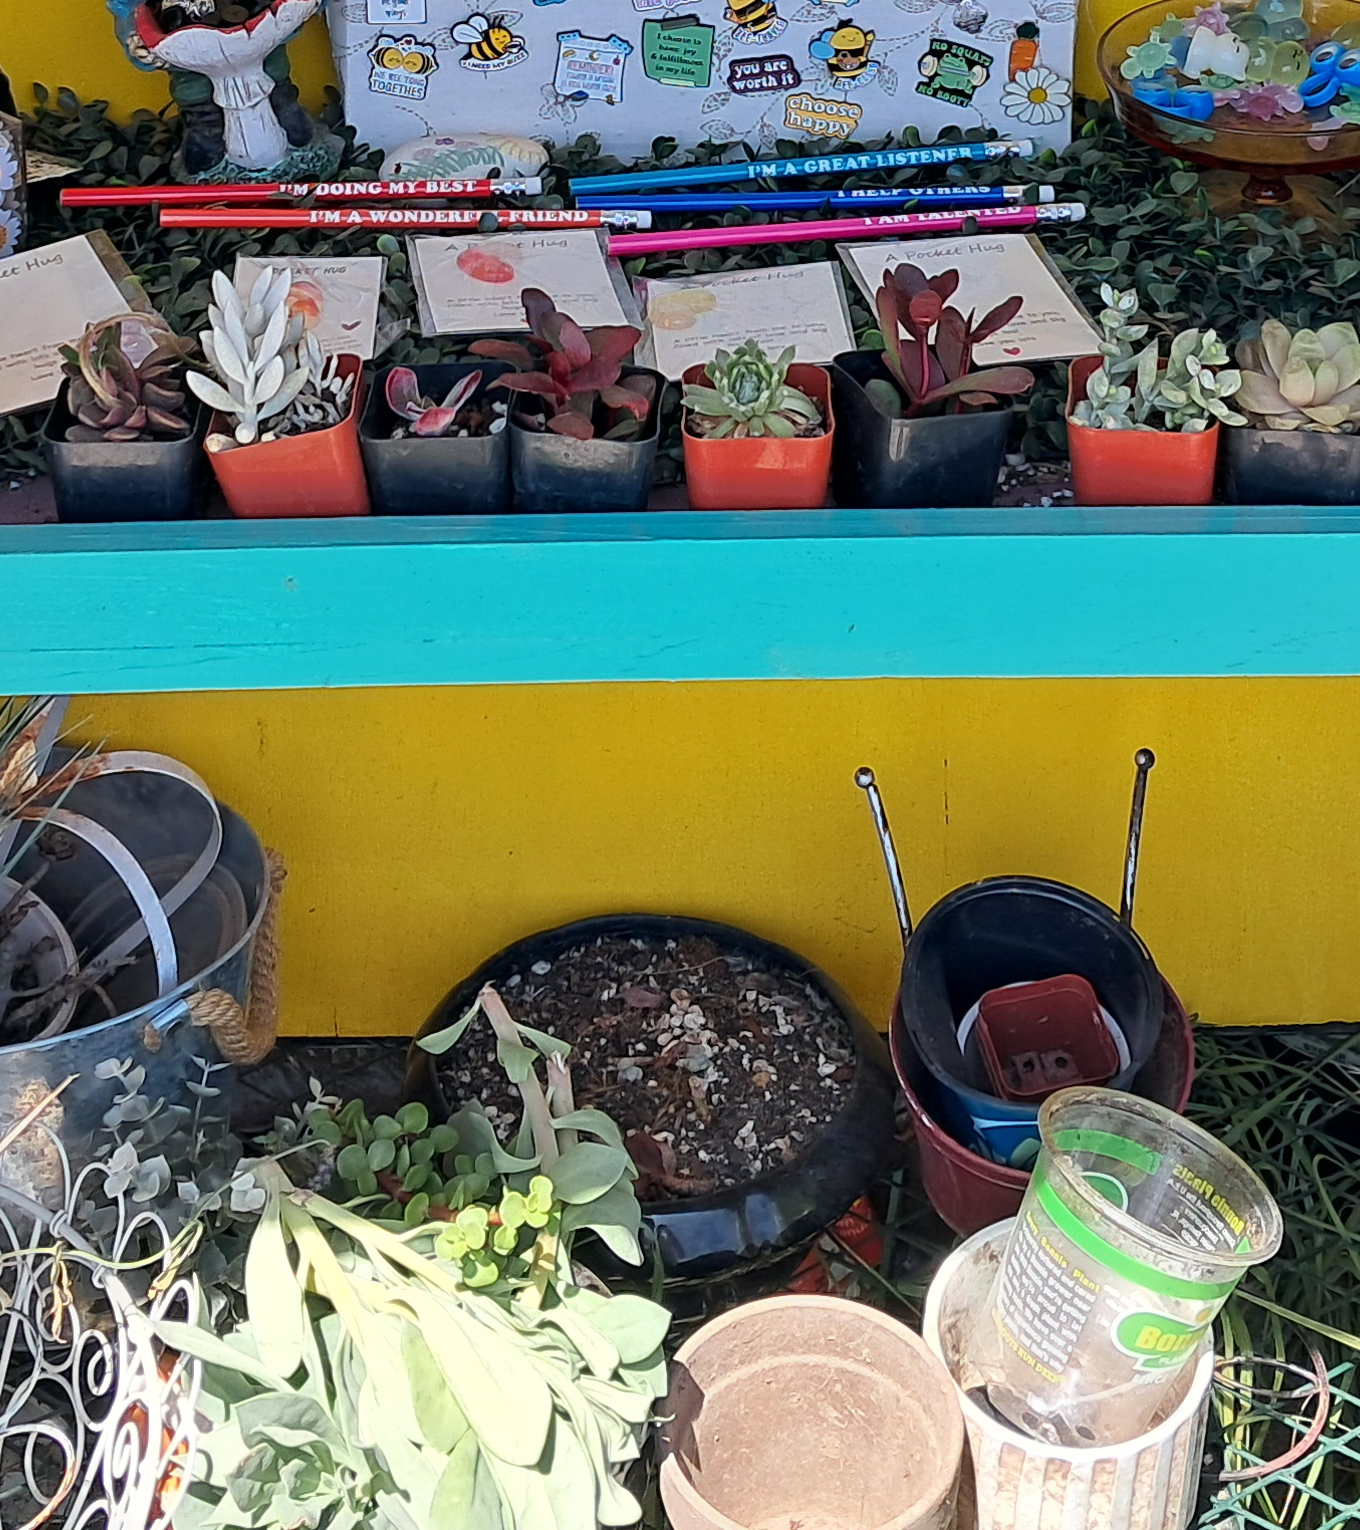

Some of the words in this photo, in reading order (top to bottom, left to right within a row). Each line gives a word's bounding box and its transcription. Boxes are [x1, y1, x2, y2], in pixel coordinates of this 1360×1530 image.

[931, 40, 948, 52] NO
[951, 45, 992, 66] SQUATS
[734, 64, 760, 78] you
[764, 60, 788, 72] are
[732, 75, 778, 90] worth
[780, 72, 794, 86] it
[788, 97, 860, 119] choose
[788, 111, 853, 137] happy
[747, 164, 776, 179] I'M
[786, 164, 799, 176] A
[804, 156, 872, 173] GREAT
[876, 147, 973, 168] LISTENER
[315, 181, 383, 195] DOING
[389, 180, 420, 195] MY
[425, 179, 477, 194] BEST
[309, 209, 340, 223] I'M
[347, 210, 362, 223] A
[509, 209, 589, 223] FRIEND
[26, 253, 64, 271] Hug
[885, 252, 897, 263] A
[904, 245, 962, 261] Pocket
[968, 242, 1005, 256] Hug
